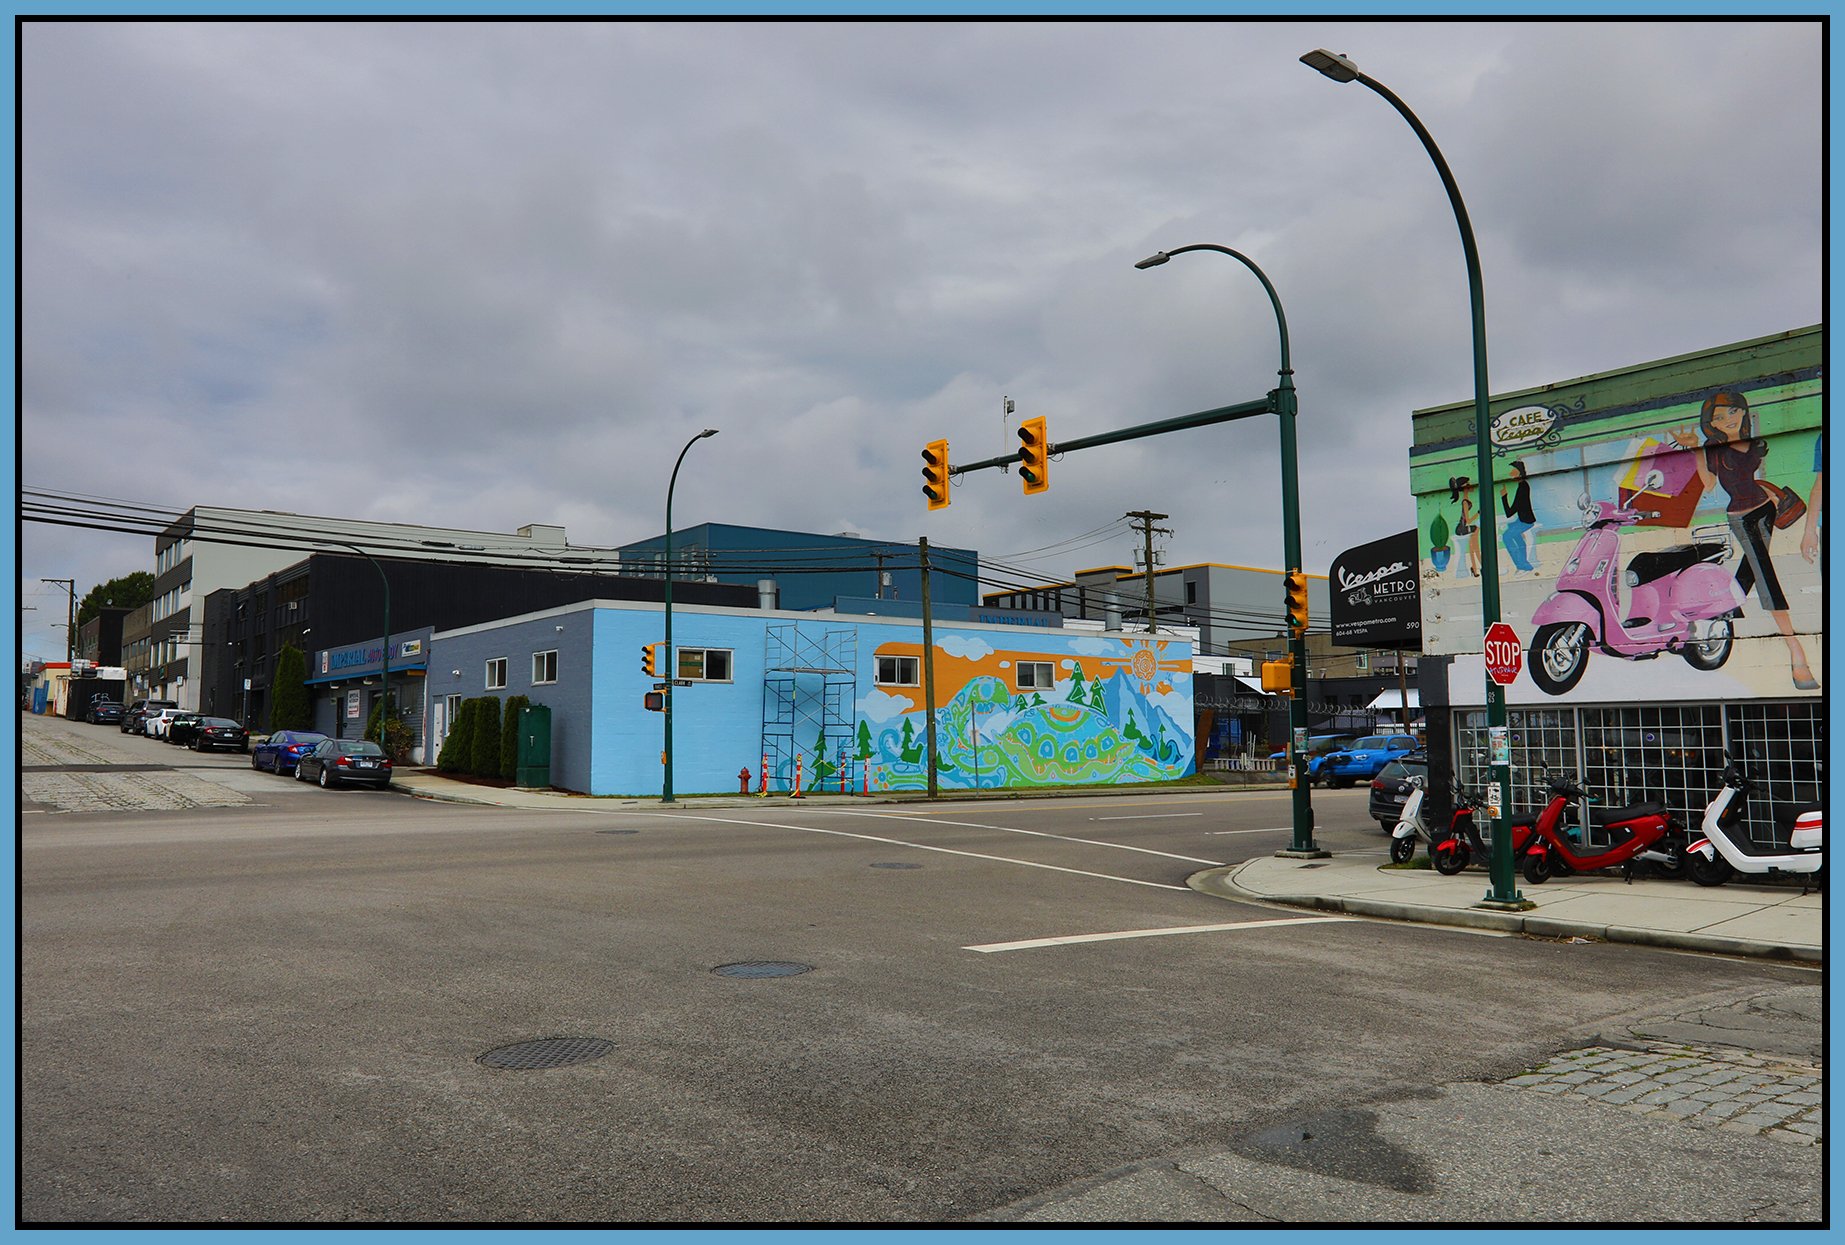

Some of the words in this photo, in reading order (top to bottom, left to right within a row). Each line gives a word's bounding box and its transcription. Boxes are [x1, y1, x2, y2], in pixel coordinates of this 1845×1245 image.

[1509, 411, 1541, 426] CAFE
[1497, 427, 1544, 442] Vespa
[1338, 561, 1409, 592] Vespa
[1373, 580, 1415, 594] METRO
[1374, 595, 1416, 603] VANCOUVER
[1406, 621, 1420, 630] 590
[331, 649, 366, 669] IMPERIAL
[1486, 641, 1520, 665] STOP
